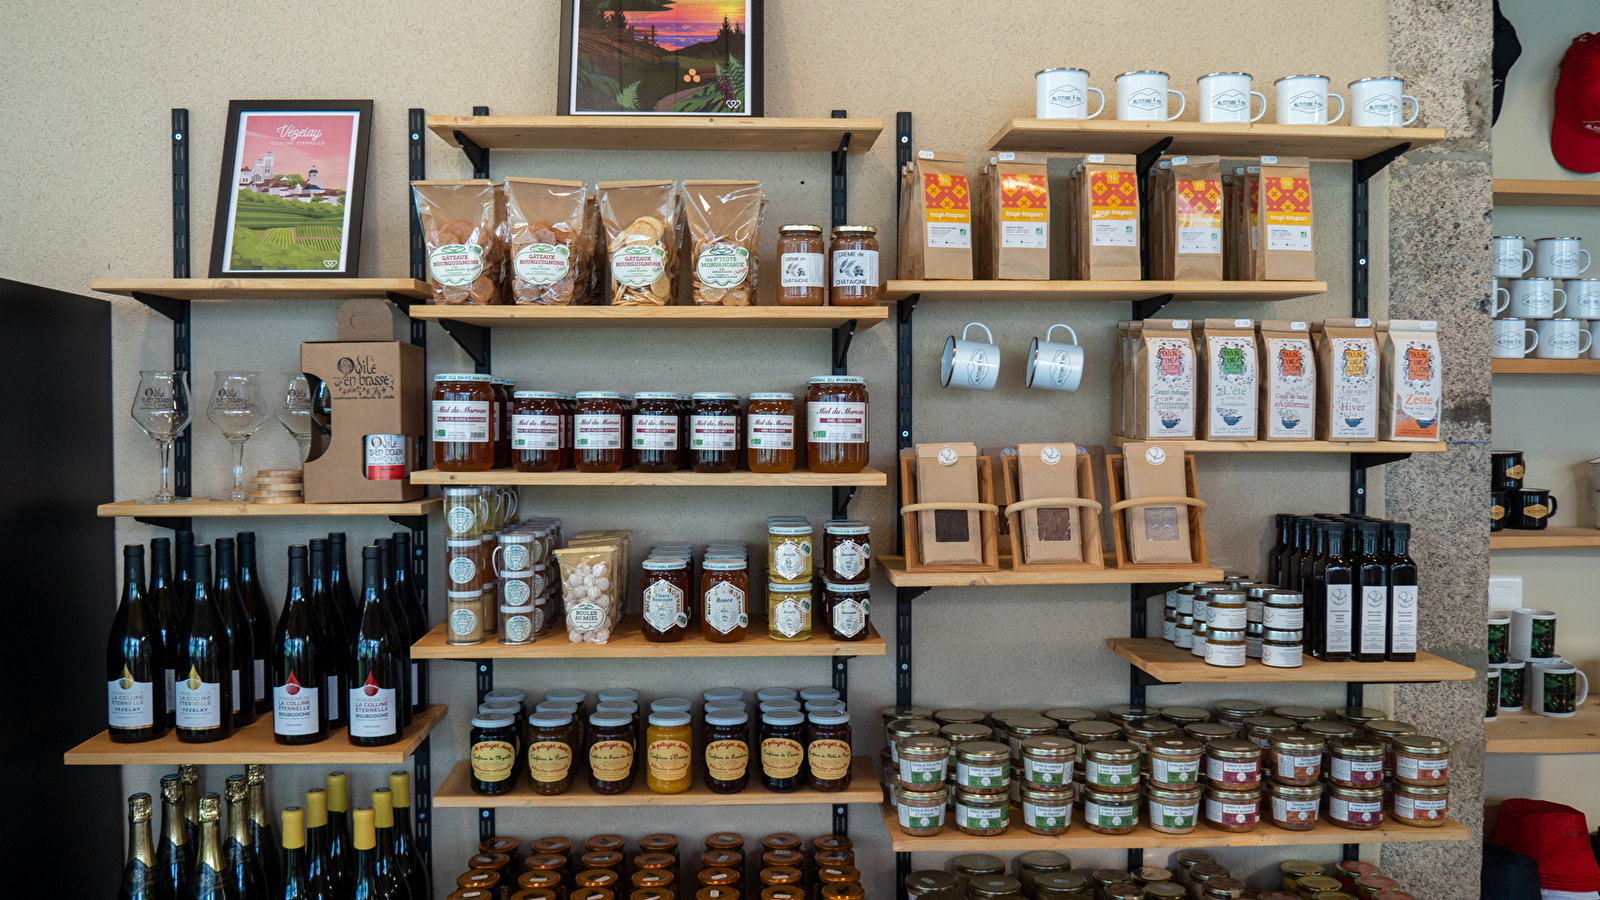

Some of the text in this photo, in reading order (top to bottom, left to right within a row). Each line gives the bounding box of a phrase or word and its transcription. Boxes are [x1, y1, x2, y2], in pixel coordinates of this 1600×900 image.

[276, 124, 322, 141] Vézelay
[1006, 210, 1044, 218] trapi-trapan
[1223, 385, 1247, 396] L'été
[1154, 400, 1190, 412] Printemps
[1405, 394, 1434, 406] Zeste
[1341, 402, 1366, 411] Hiver
[667, 587, 681, 612] MORVAN
